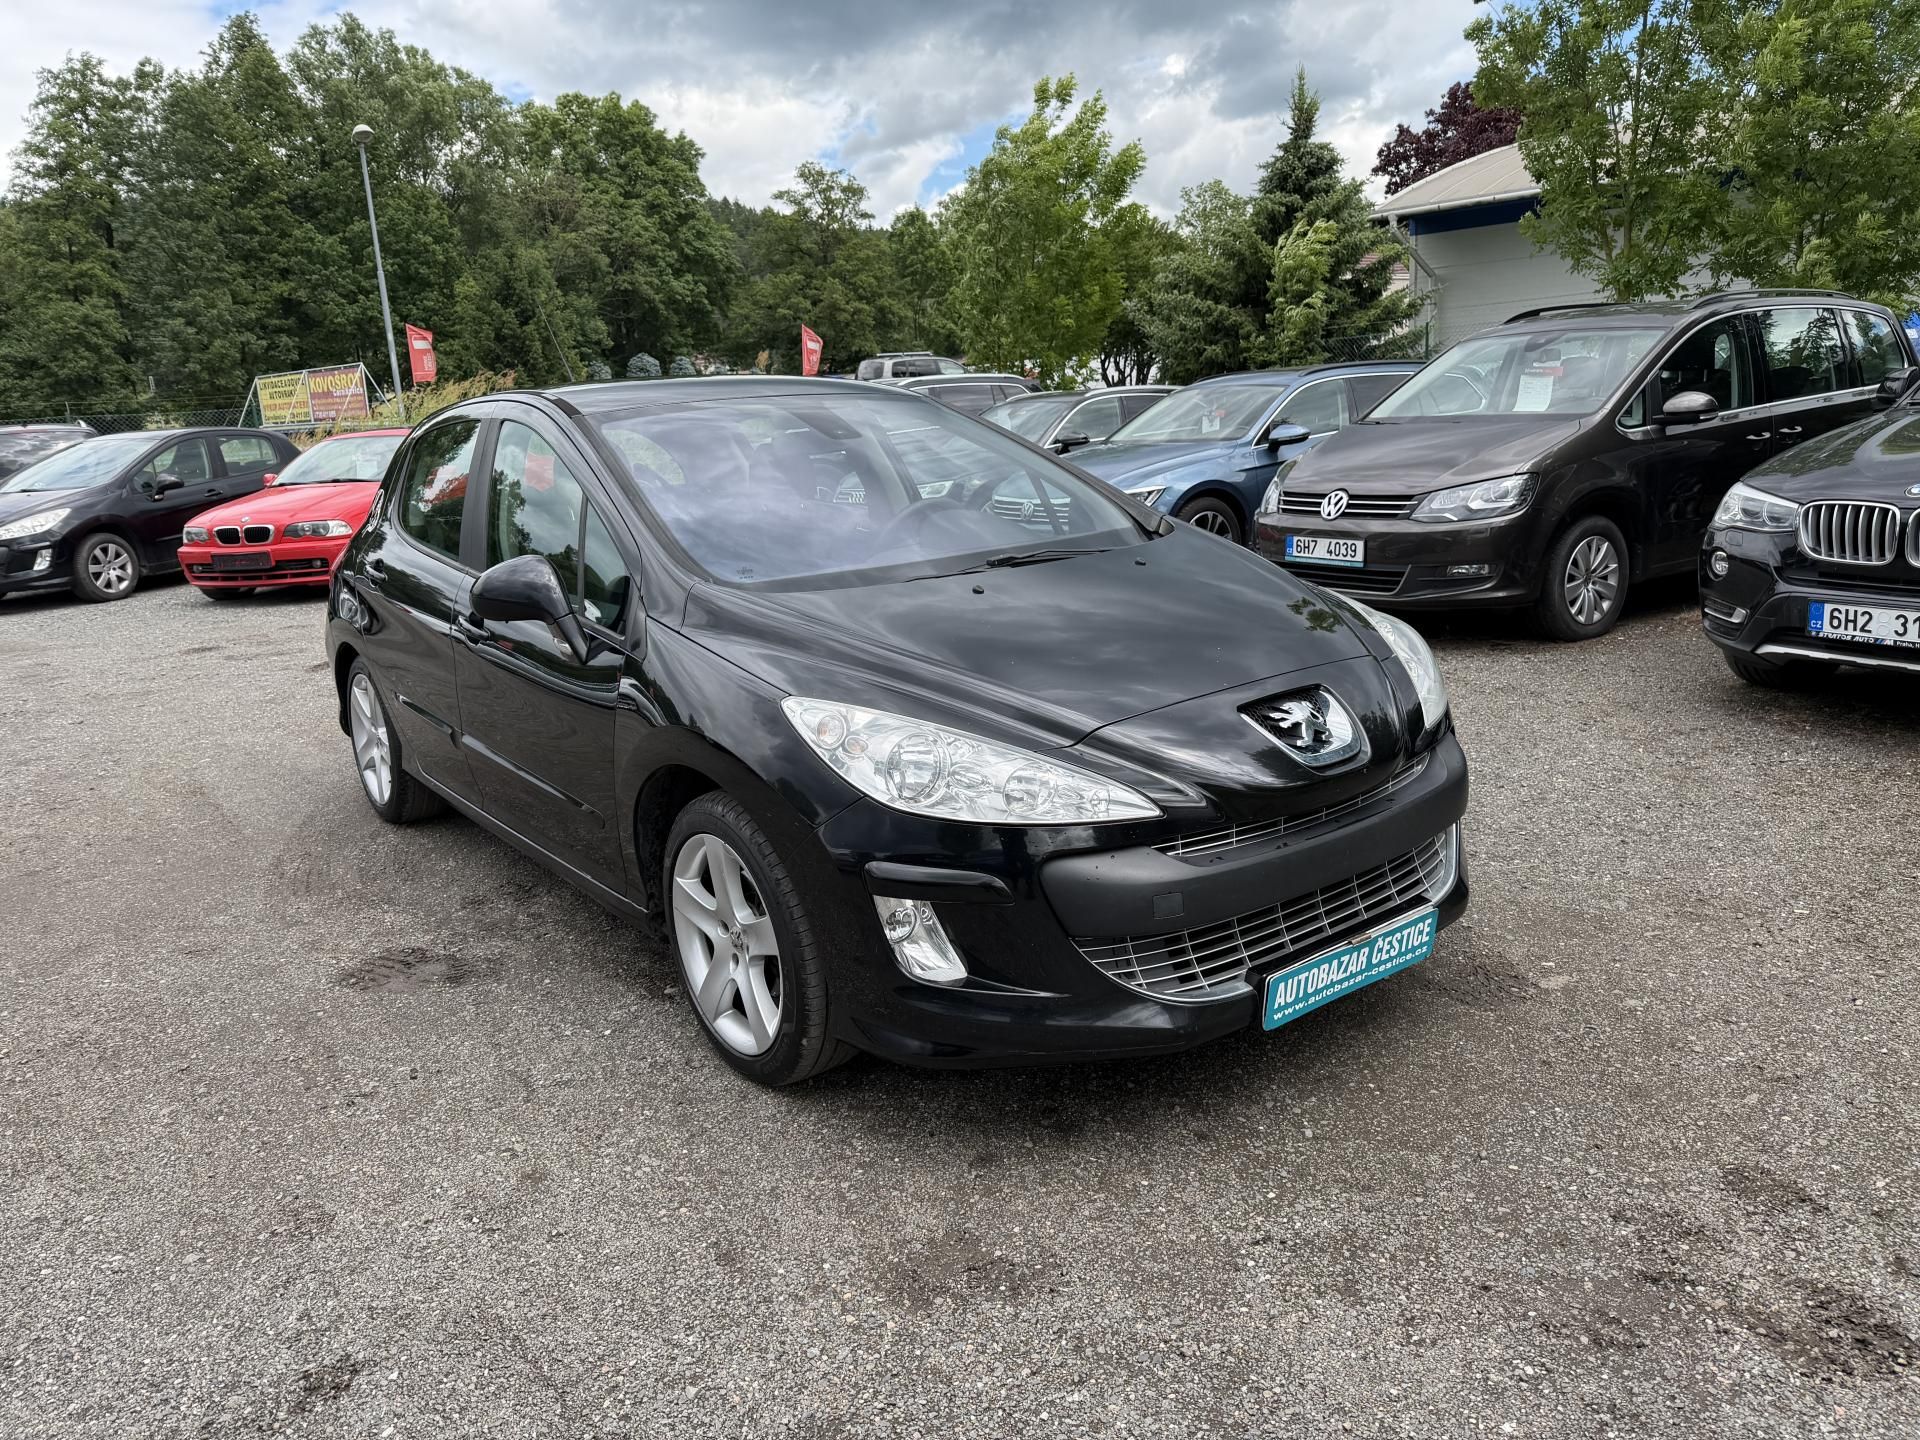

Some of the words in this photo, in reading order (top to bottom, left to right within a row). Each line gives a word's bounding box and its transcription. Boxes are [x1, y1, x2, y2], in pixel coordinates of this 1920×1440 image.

[269, 388, 297, 400] AUTOVRAK
[1296, 539, 1318, 555] 6H7
[1327, 541, 1357, 558] 4039
[1811, 620, 1822, 628] CZ
[1829, 608, 1873, 633] 6H2
[1893, 613, 1920, 638] 31
[1853, 635, 1875, 644] AUTO
[1273, 946, 1369, 1010] AUTOBAZAR
[1371, 917, 1432, 965] ČESTICE
[1272, 945, 1428, 1021] www.autobazar-cestice.cz
